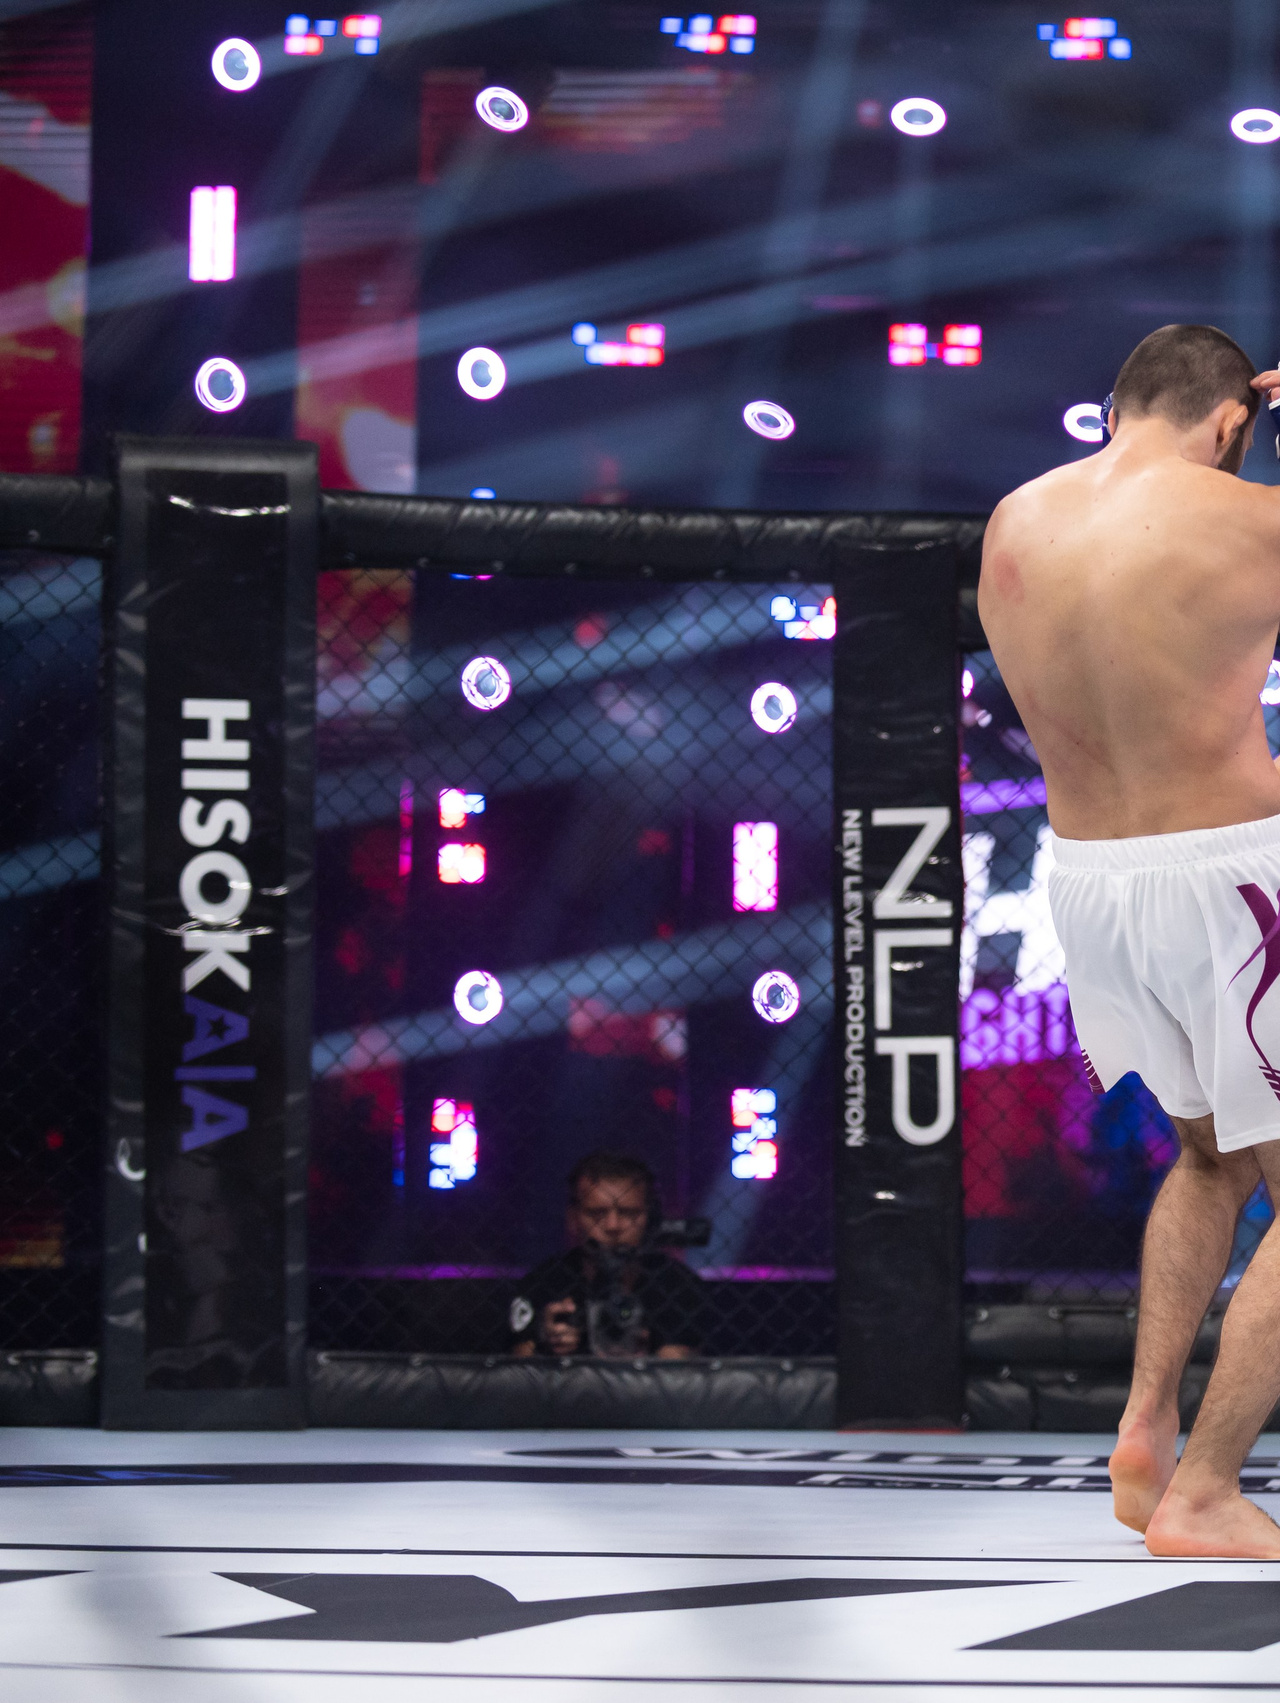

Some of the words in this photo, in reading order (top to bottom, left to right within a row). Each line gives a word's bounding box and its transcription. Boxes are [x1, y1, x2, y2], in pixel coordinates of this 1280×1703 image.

[842, 809, 863, 872] NEW
[843, 876, 865, 963] LEVEL
[871, 806, 955, 1146] NLP
[845, 965, 866, 1147] PRODUCTION
